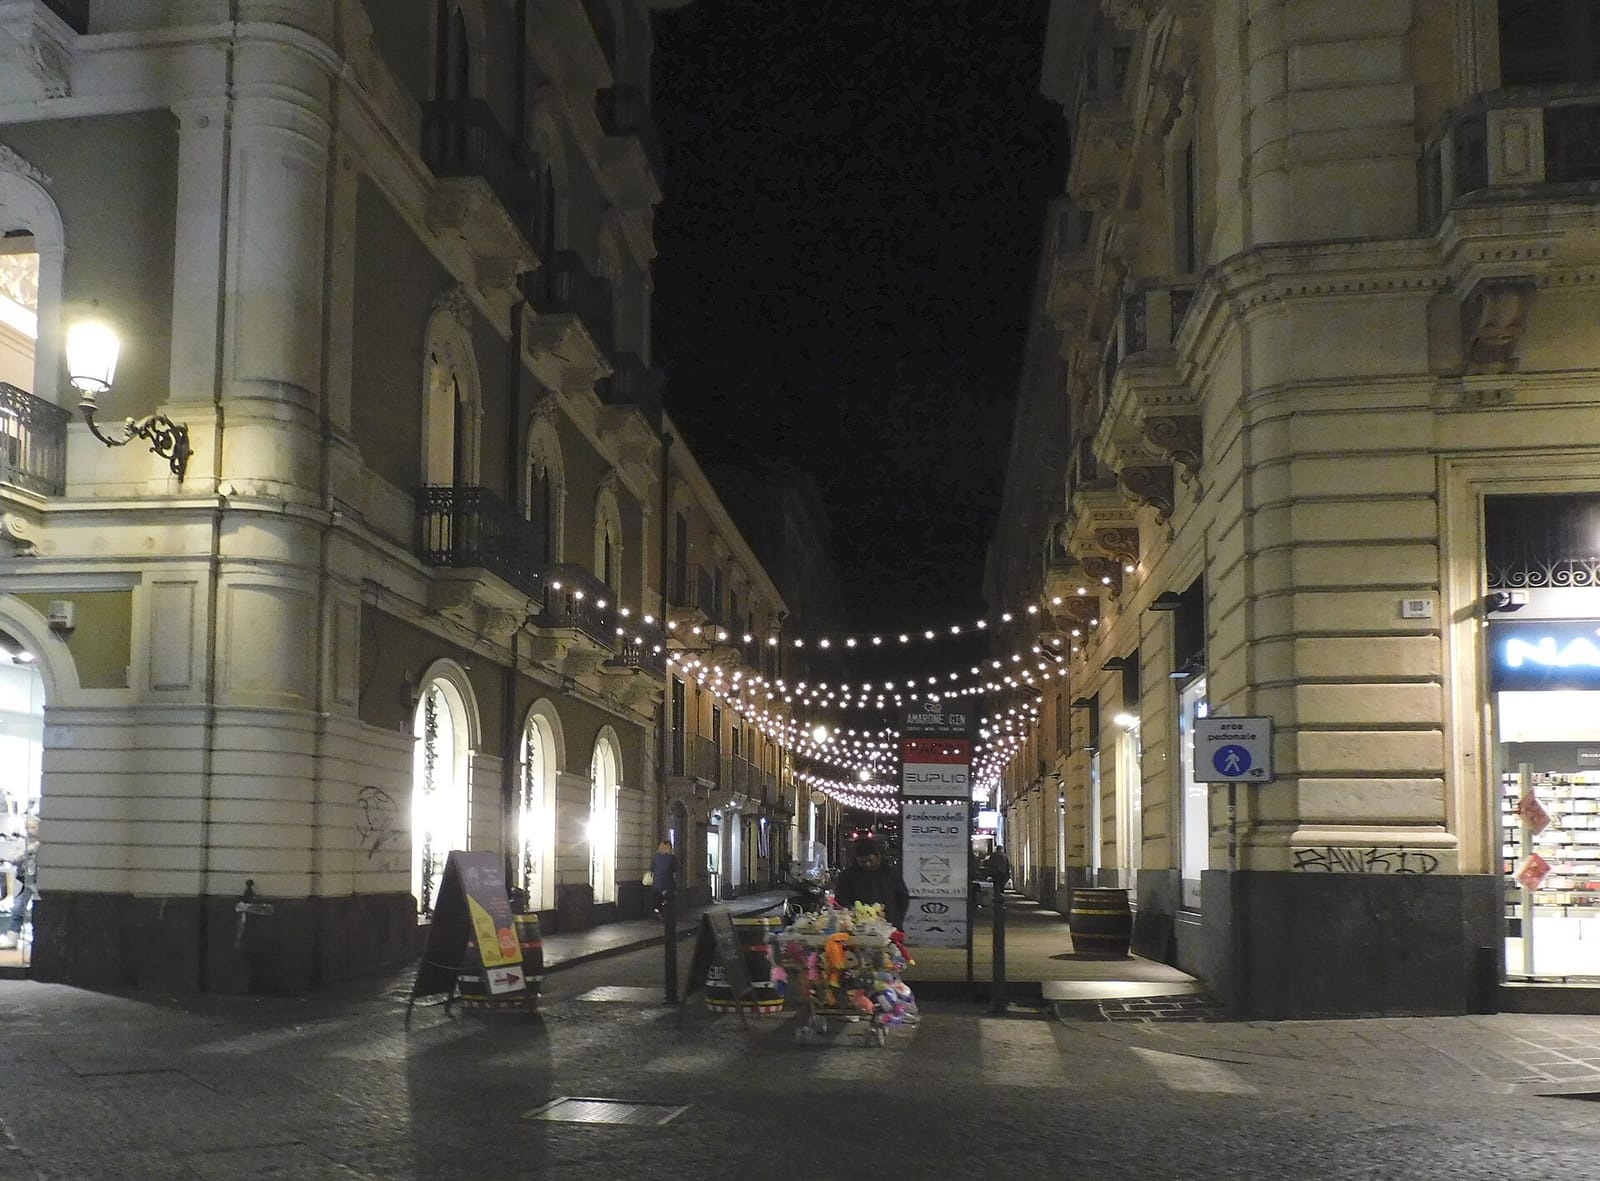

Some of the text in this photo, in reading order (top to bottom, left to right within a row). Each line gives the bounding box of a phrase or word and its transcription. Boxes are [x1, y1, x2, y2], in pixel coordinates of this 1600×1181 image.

[1506, 629, 1600, 668] NA
[1207, 733, 1257, 741] pedonale
[905, 773, 966, 783] EUPLIO
[911, 825, 960, 834] EUPLIO
